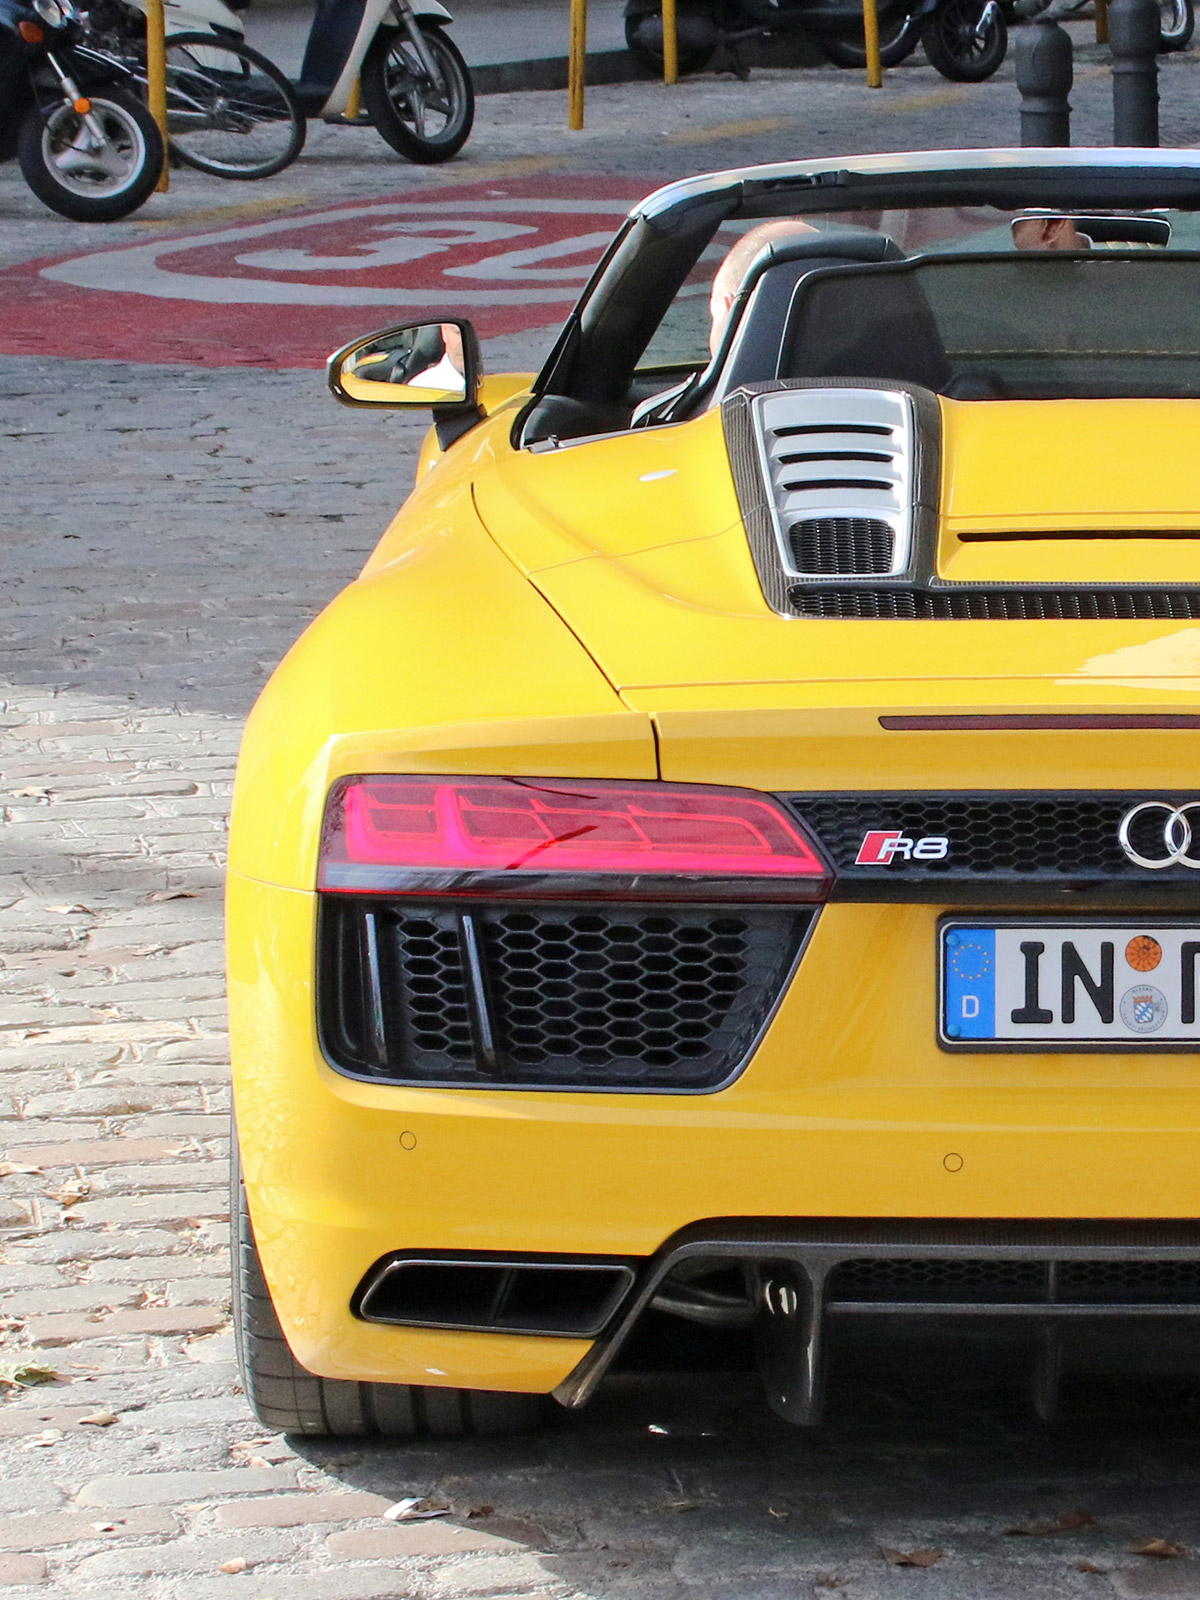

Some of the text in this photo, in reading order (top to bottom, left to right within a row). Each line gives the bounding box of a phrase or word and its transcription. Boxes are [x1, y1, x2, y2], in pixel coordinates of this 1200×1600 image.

[877, 837, 949, 860] R8
[1010, 941, 1115, 1025] IN
[961, 994, 980, 1018] D
